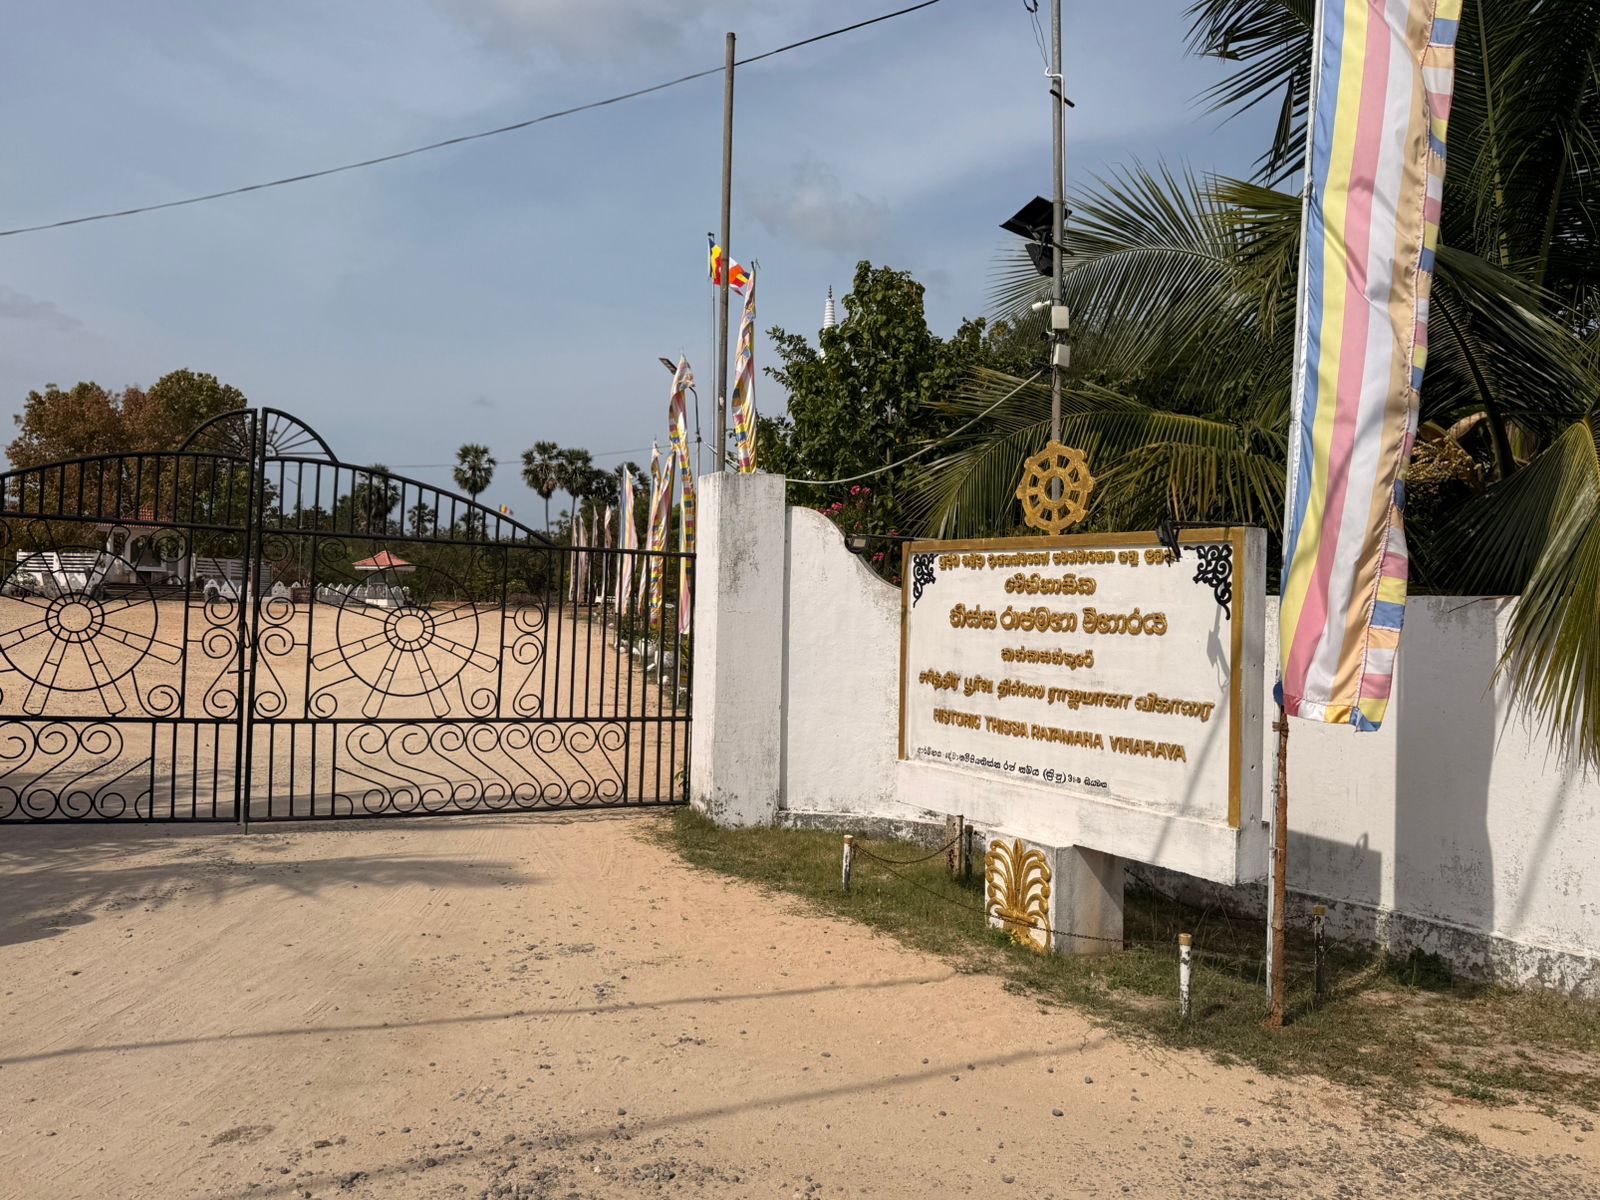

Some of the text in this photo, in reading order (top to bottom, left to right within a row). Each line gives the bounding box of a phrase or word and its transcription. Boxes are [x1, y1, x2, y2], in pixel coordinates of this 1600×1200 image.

[1004, 573, 1098, 596] ඓතිහාසික
[949, 603, 1169, 636] තිස්ස රාජමහා විහාරය
[933, 708, 1188, 762] HISTORIC THISSA RAJAMAHA VIHARAYA
